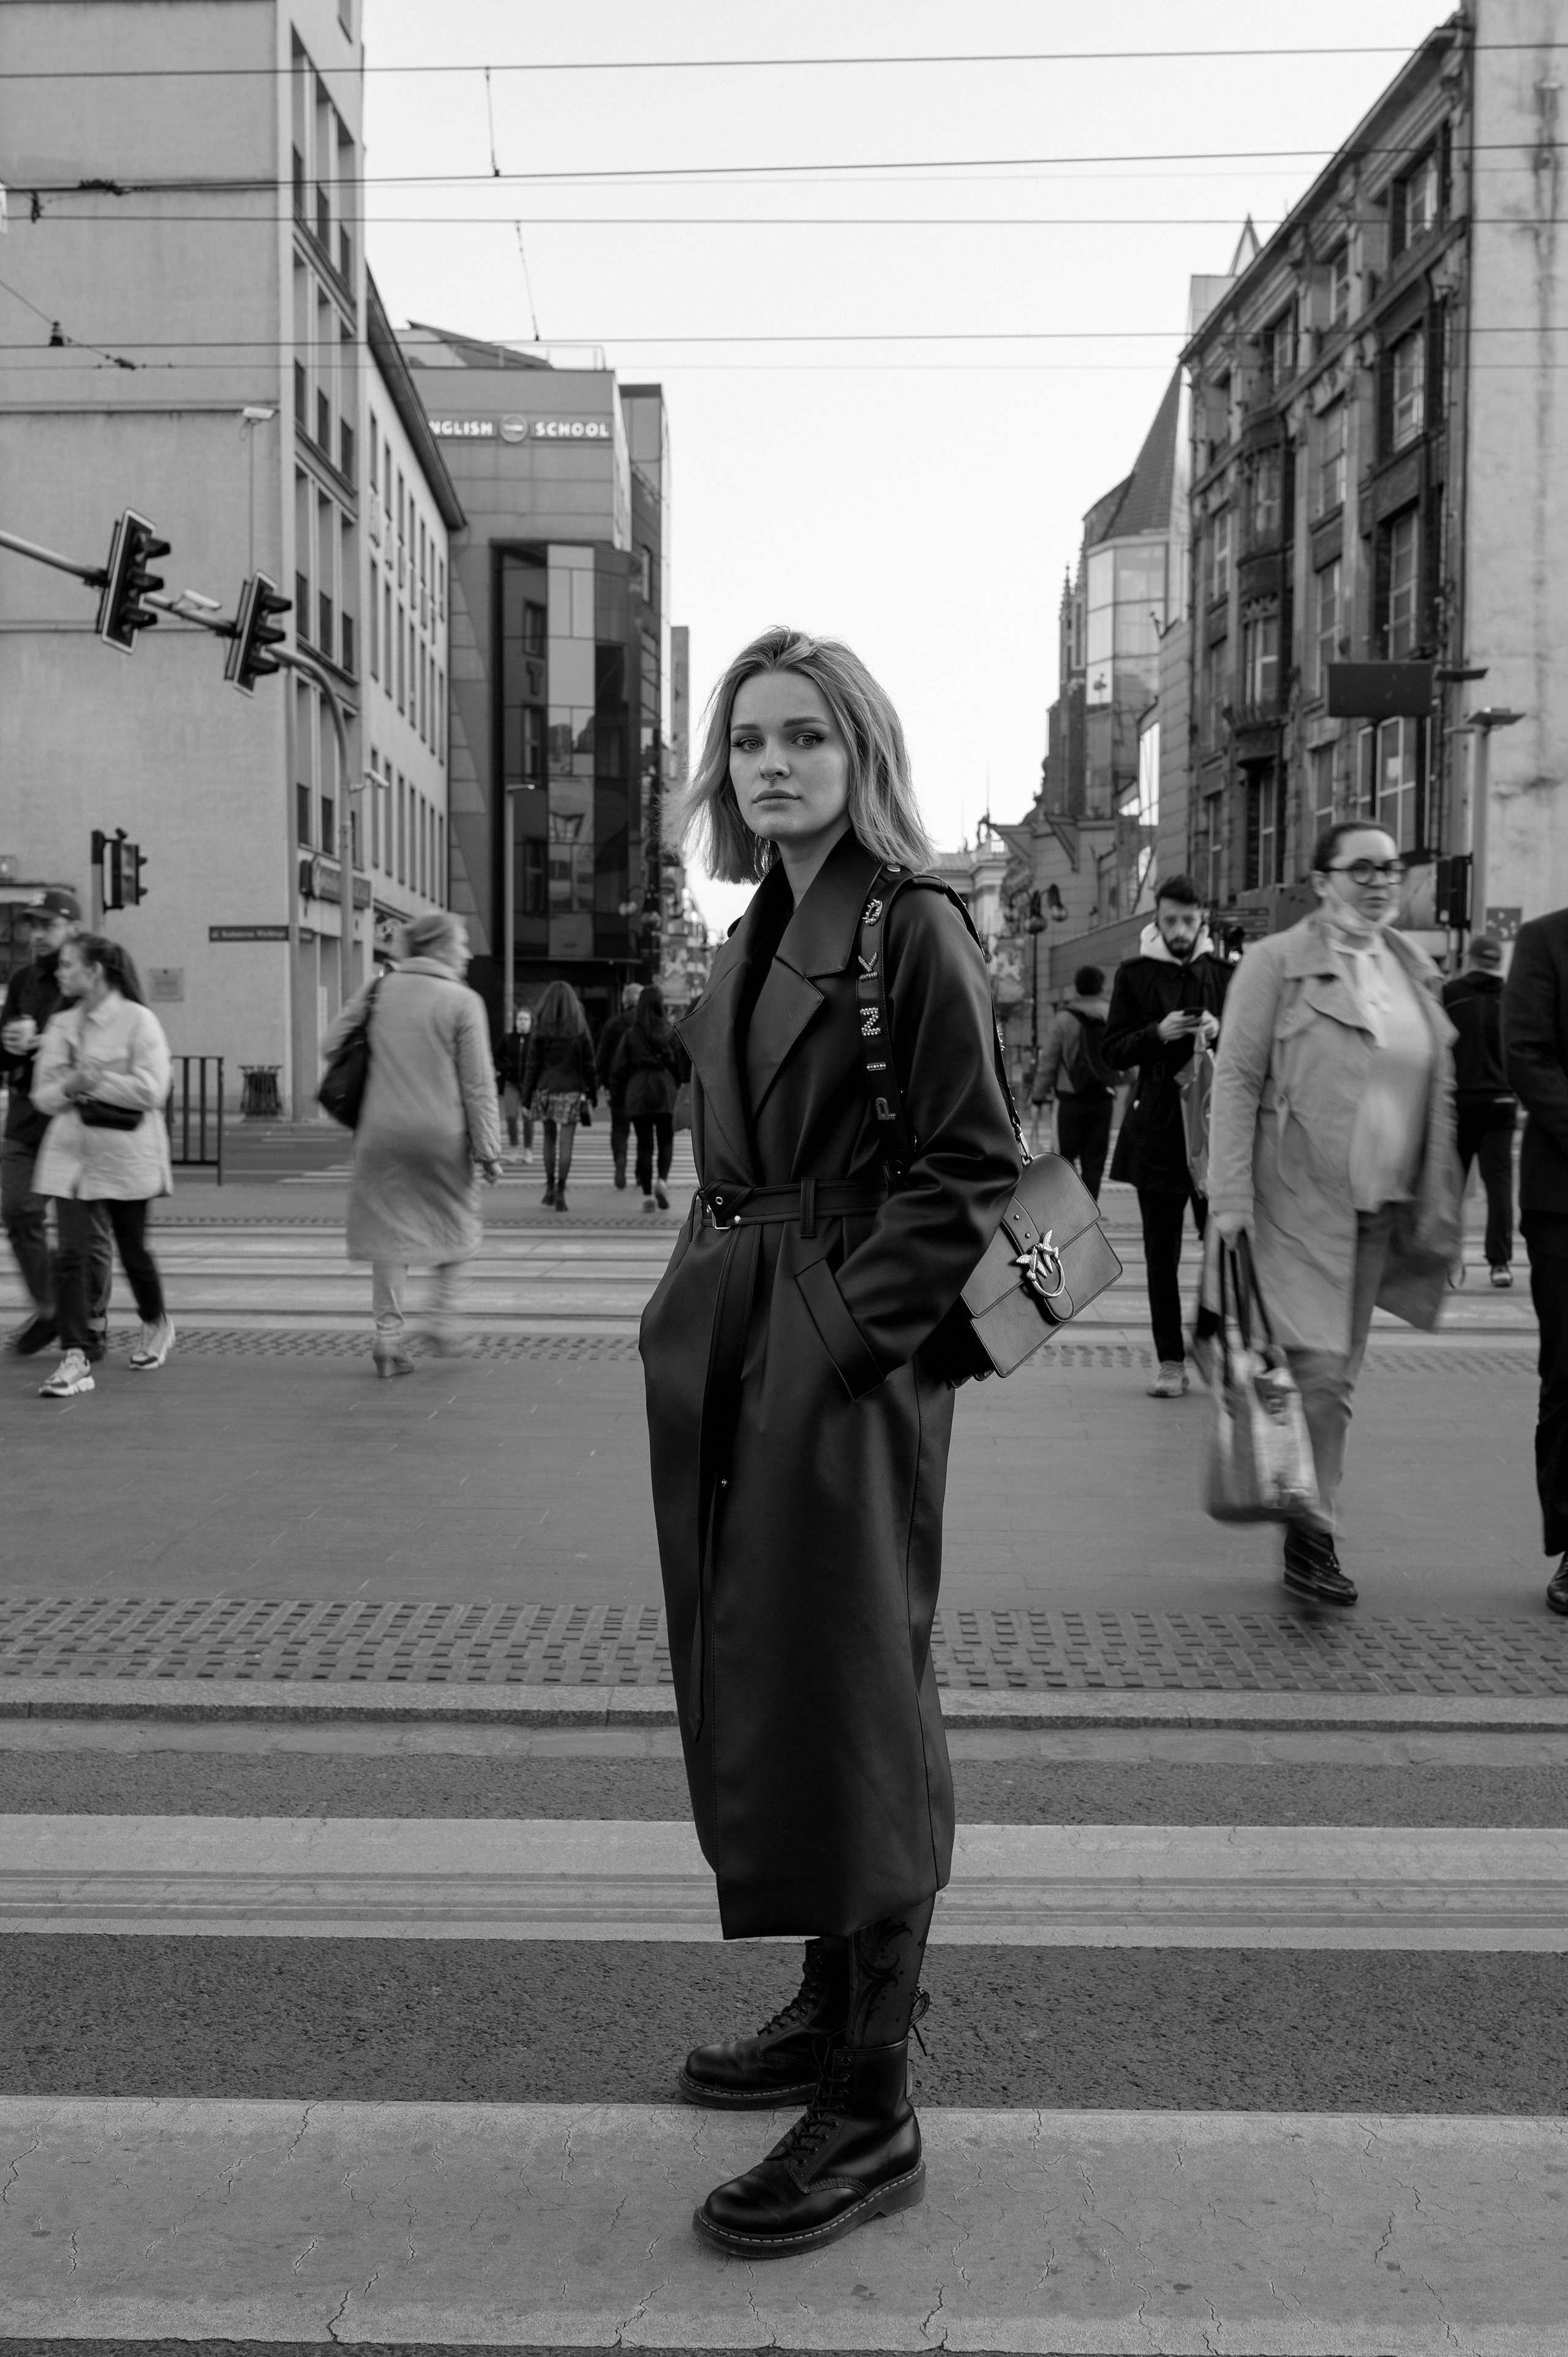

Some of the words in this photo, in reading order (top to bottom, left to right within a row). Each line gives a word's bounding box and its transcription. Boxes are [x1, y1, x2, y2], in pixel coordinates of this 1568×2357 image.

[429, 420, 492, 435] NGLISH
[535, 422, 609, 437] SCHOOL
[858, 898, 896, 1120] PINKO
